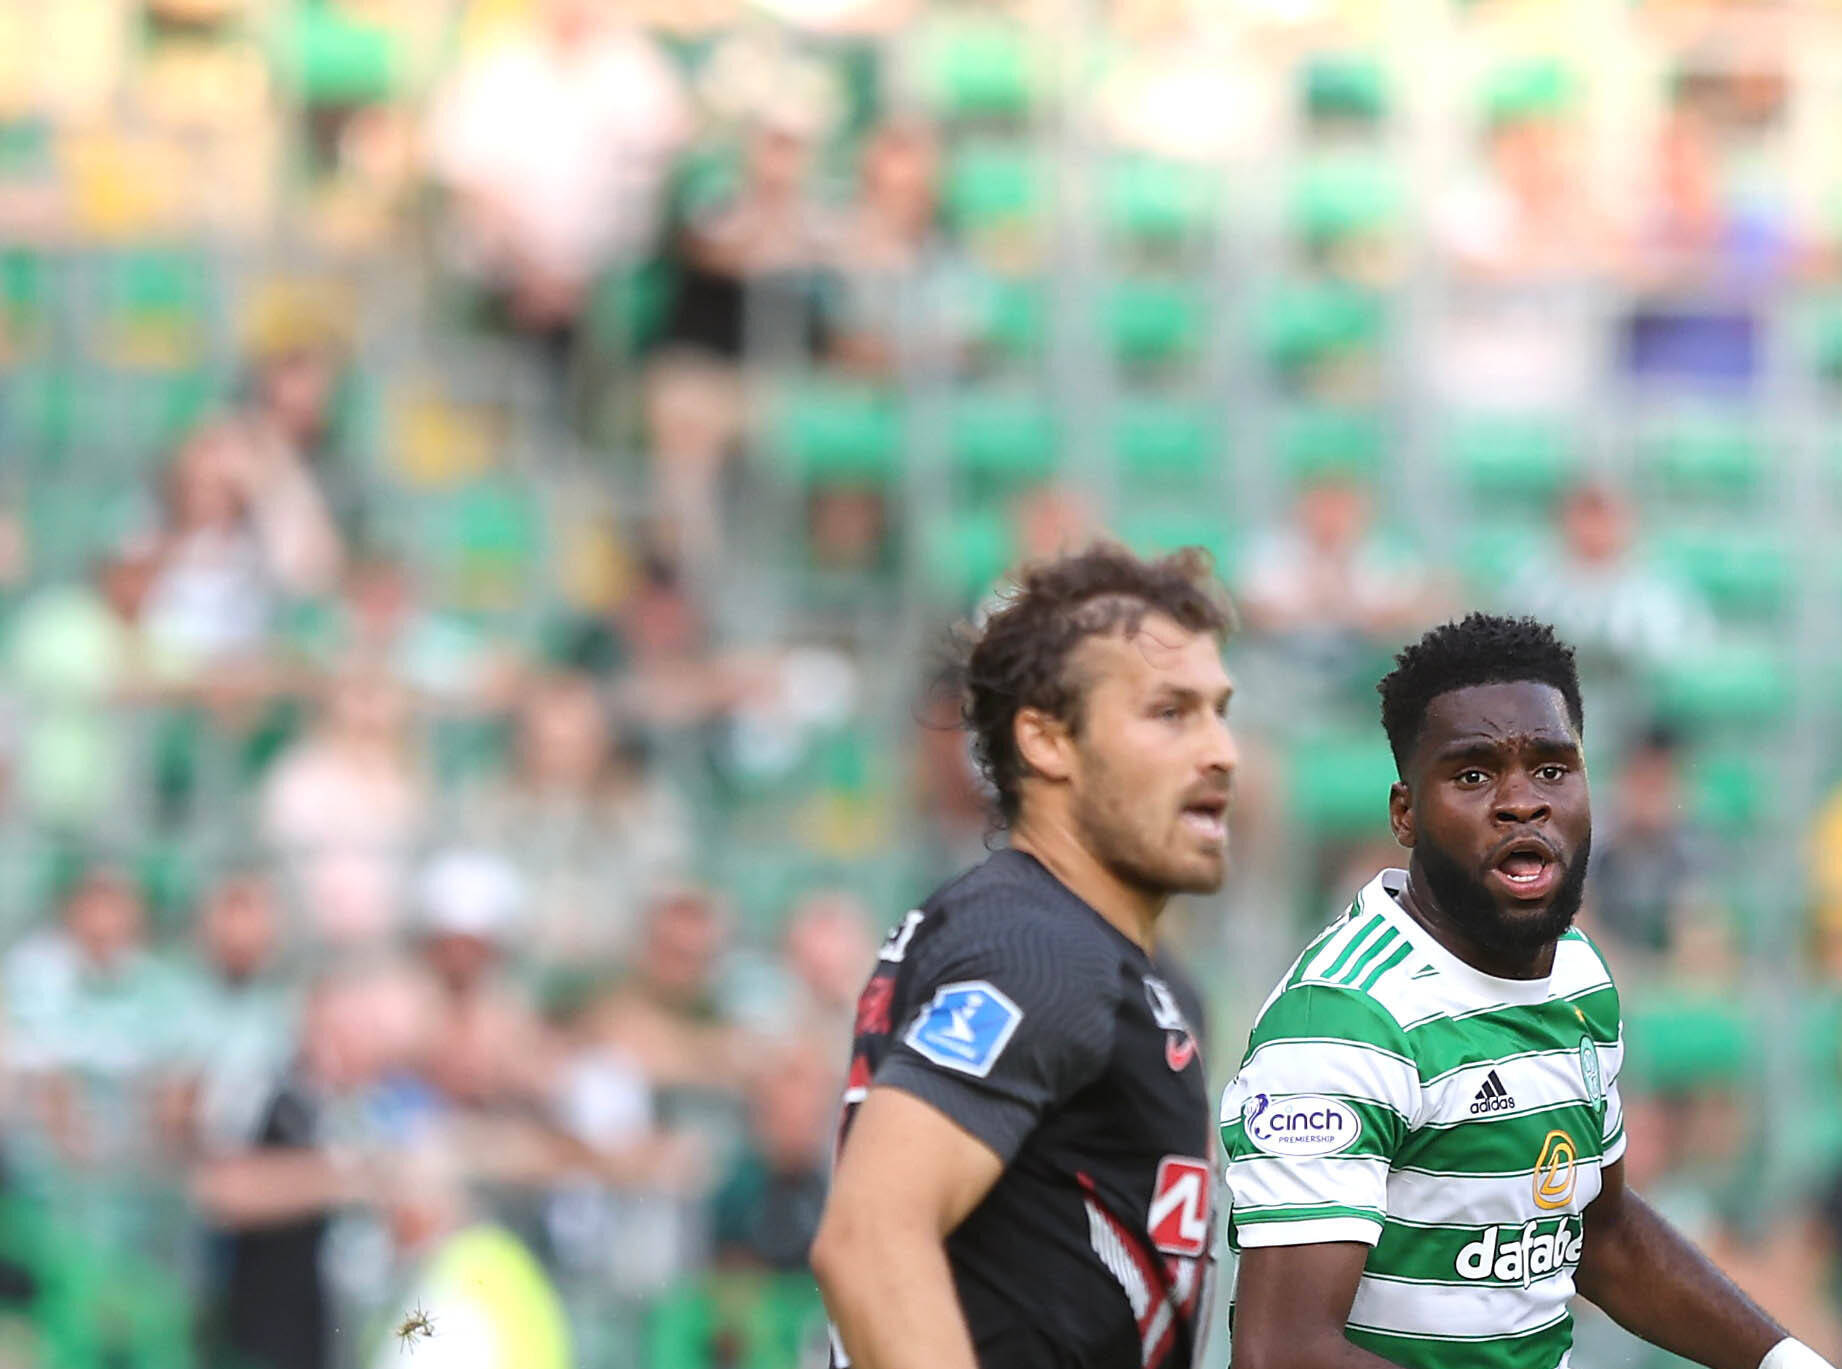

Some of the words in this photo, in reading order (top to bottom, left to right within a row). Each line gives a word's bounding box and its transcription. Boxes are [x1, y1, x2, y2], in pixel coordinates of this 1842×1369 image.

[1470, 1096, 1516, 1114] adidas
[1269, 1108, 1343, 1131] cinch
[1278, 1135, 1335, 1144] PREMIERSHIP
